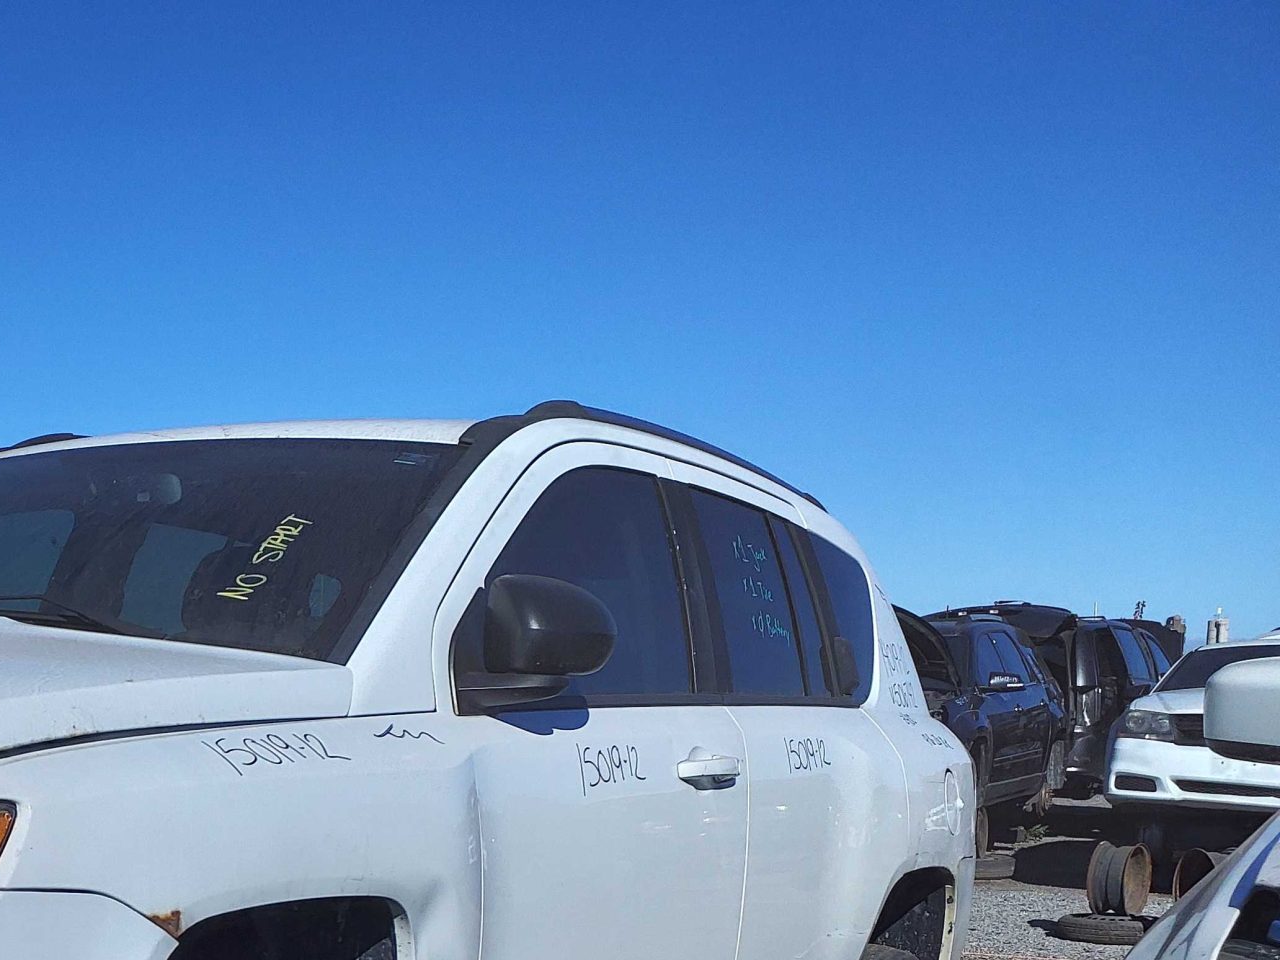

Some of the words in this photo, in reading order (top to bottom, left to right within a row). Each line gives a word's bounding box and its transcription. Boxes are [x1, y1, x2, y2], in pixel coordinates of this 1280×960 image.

[217, 573, 267, 600] NO
[252, 514, 314, 564] START
[201, 733, 352, 776] 15019-12
[576, 743, 646, 797] 15019-12
[783, 736, 832, 774] 15019-12
